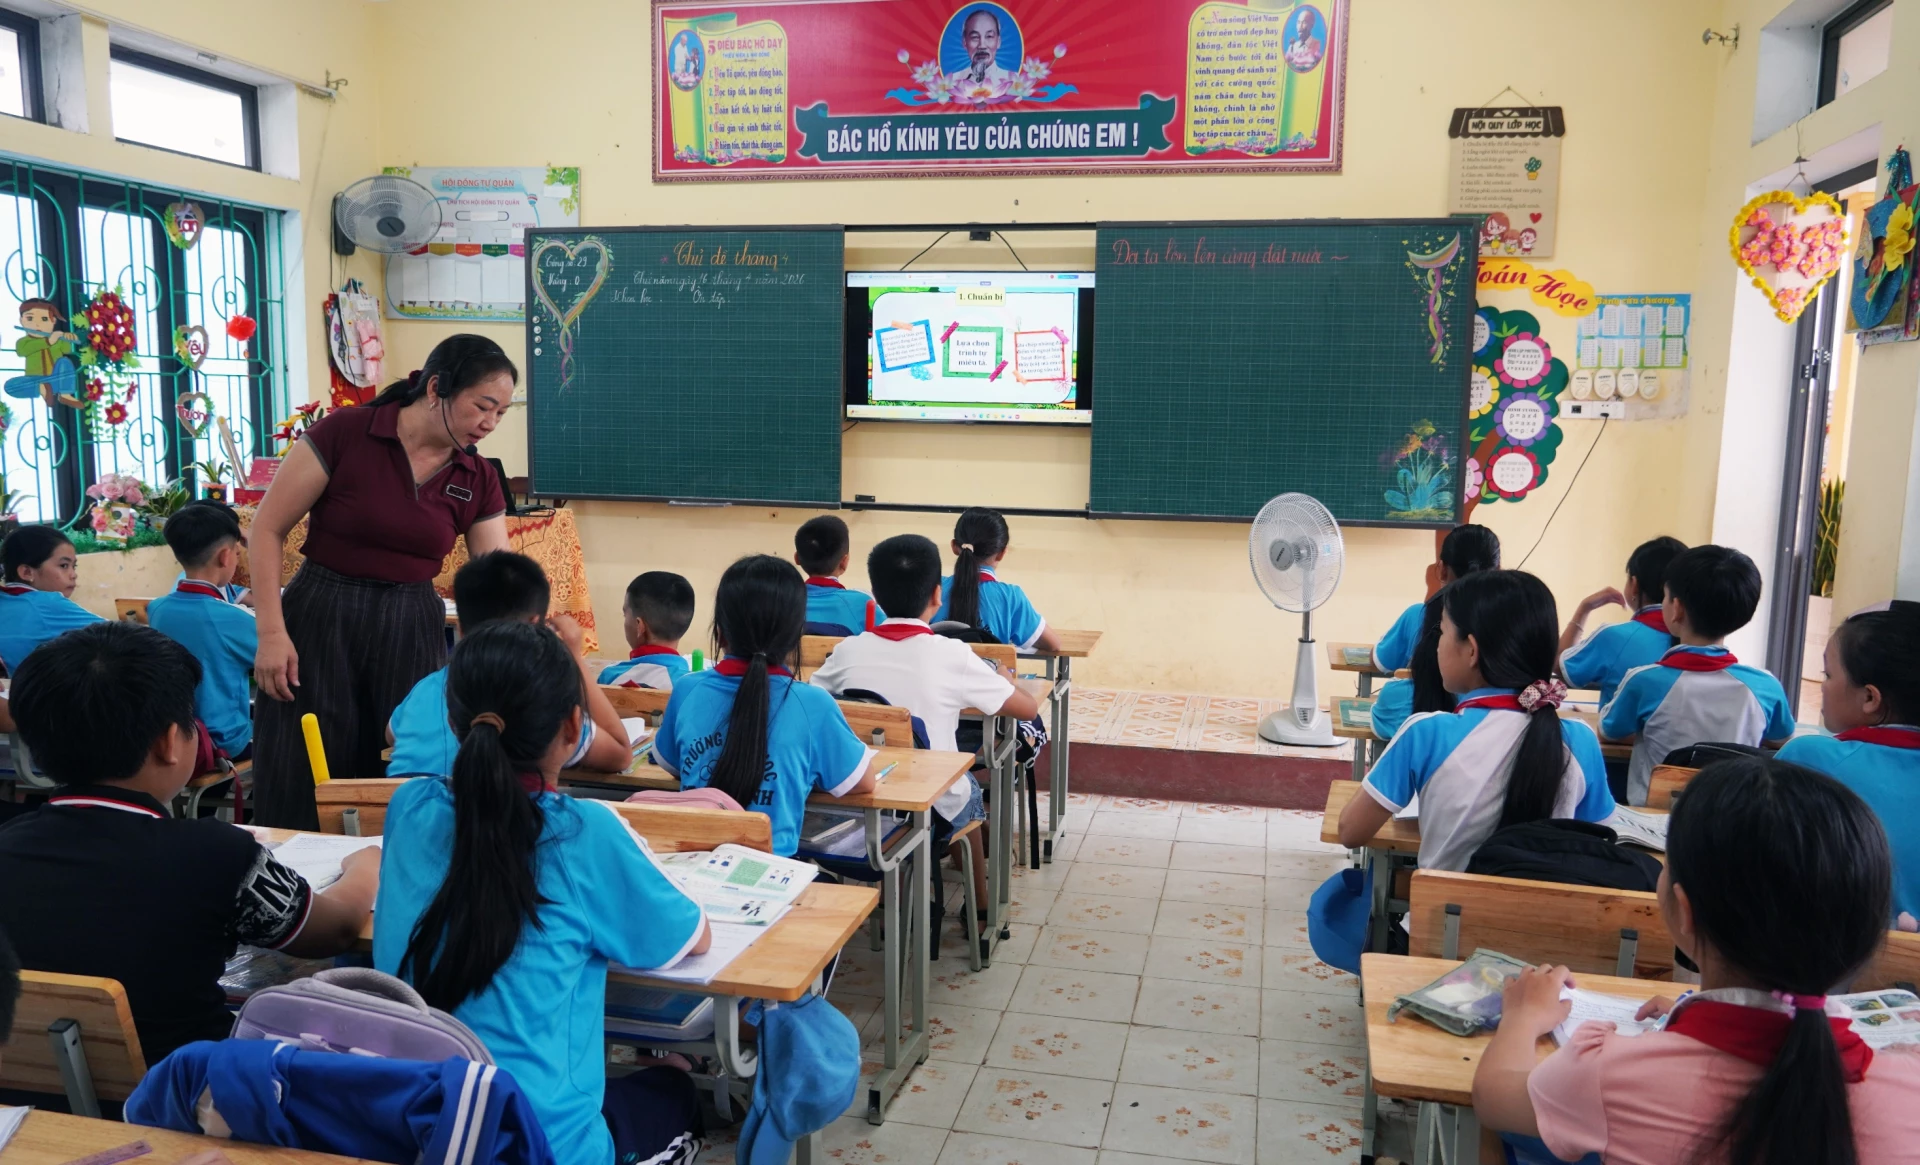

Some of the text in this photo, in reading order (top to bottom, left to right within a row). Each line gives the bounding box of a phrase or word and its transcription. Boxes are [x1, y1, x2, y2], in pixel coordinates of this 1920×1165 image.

[1247, 14, 1262, 23] Việt
[1250, 28, 1264, 38] đẹp
[1265, 27, 1279, 36] hay
[708, 40, 716, 55] 5
[717, 36, 735, 50] ĐIỀU
[737, 37, 752, 50] BÁC
[754, 36, 765, 49] HỒ
[767, 38, 783, 51] DẠY
[1262, 40, 1278, 48] Việt
[1256, 77, 1276, 88] quốc
[1261, 91, 1276, 99] hay
[1256, 117, 1275, 125] công
[1471, 119, 1542, 131] NỘI QUY LỚP HỌC
[828, 121, 862, 153] BÁC
[868, 121, 891, 152] HỒ
[896, 122, 939, 151] KÍNH
[945, 121, 979, 150] YÊU
[985, 117, 1021, 150] CỦA
[1027, 119, 1090, 148] CHÚNG
[1096, 123, 1125, 147] EM
[1193, 130, 1206, 138] học
[1206, 130, 1219, 138] tập
[1219, 129, 1232, 137] của
[1233, 129, 1245, 137] các
[442, 177, 515, 190] HỘI ĐỒNG TỰ QUẢN
[673, 240, 789, 272] Chủ đề tháng 4
[1144, 248, 1159, 264] ta
[1164, 237, 1187, 263] lớn
[1194, 237, 1217, 264] lên
[1222, 248, 1257, 268] cùng
[1262, 242, 1286, 264] đất
[1290, 247, 1324, 264] nước
[577, 256, 588, 267] 29
[574, 276, 580, 286] 0
[633, 270, 652, 285] Thứ
[653, 274, 673, 285] năm
[672, 275, 697, 292] ngày
[700, 272, 708, 284] 16
[712, 270, 742, 292] tháng
[754, 273, 778, 285] năm
[780, 273, 805, 285] 2026
[1475, 261, 1589, 311] Toán Học
[967, 292, 993, 301] Chuẩn
[994, 293, 1003, 302] bị
[1641, 297, 1675, 305] chương
[681, 731, 723, 776] TRƯỜNG
